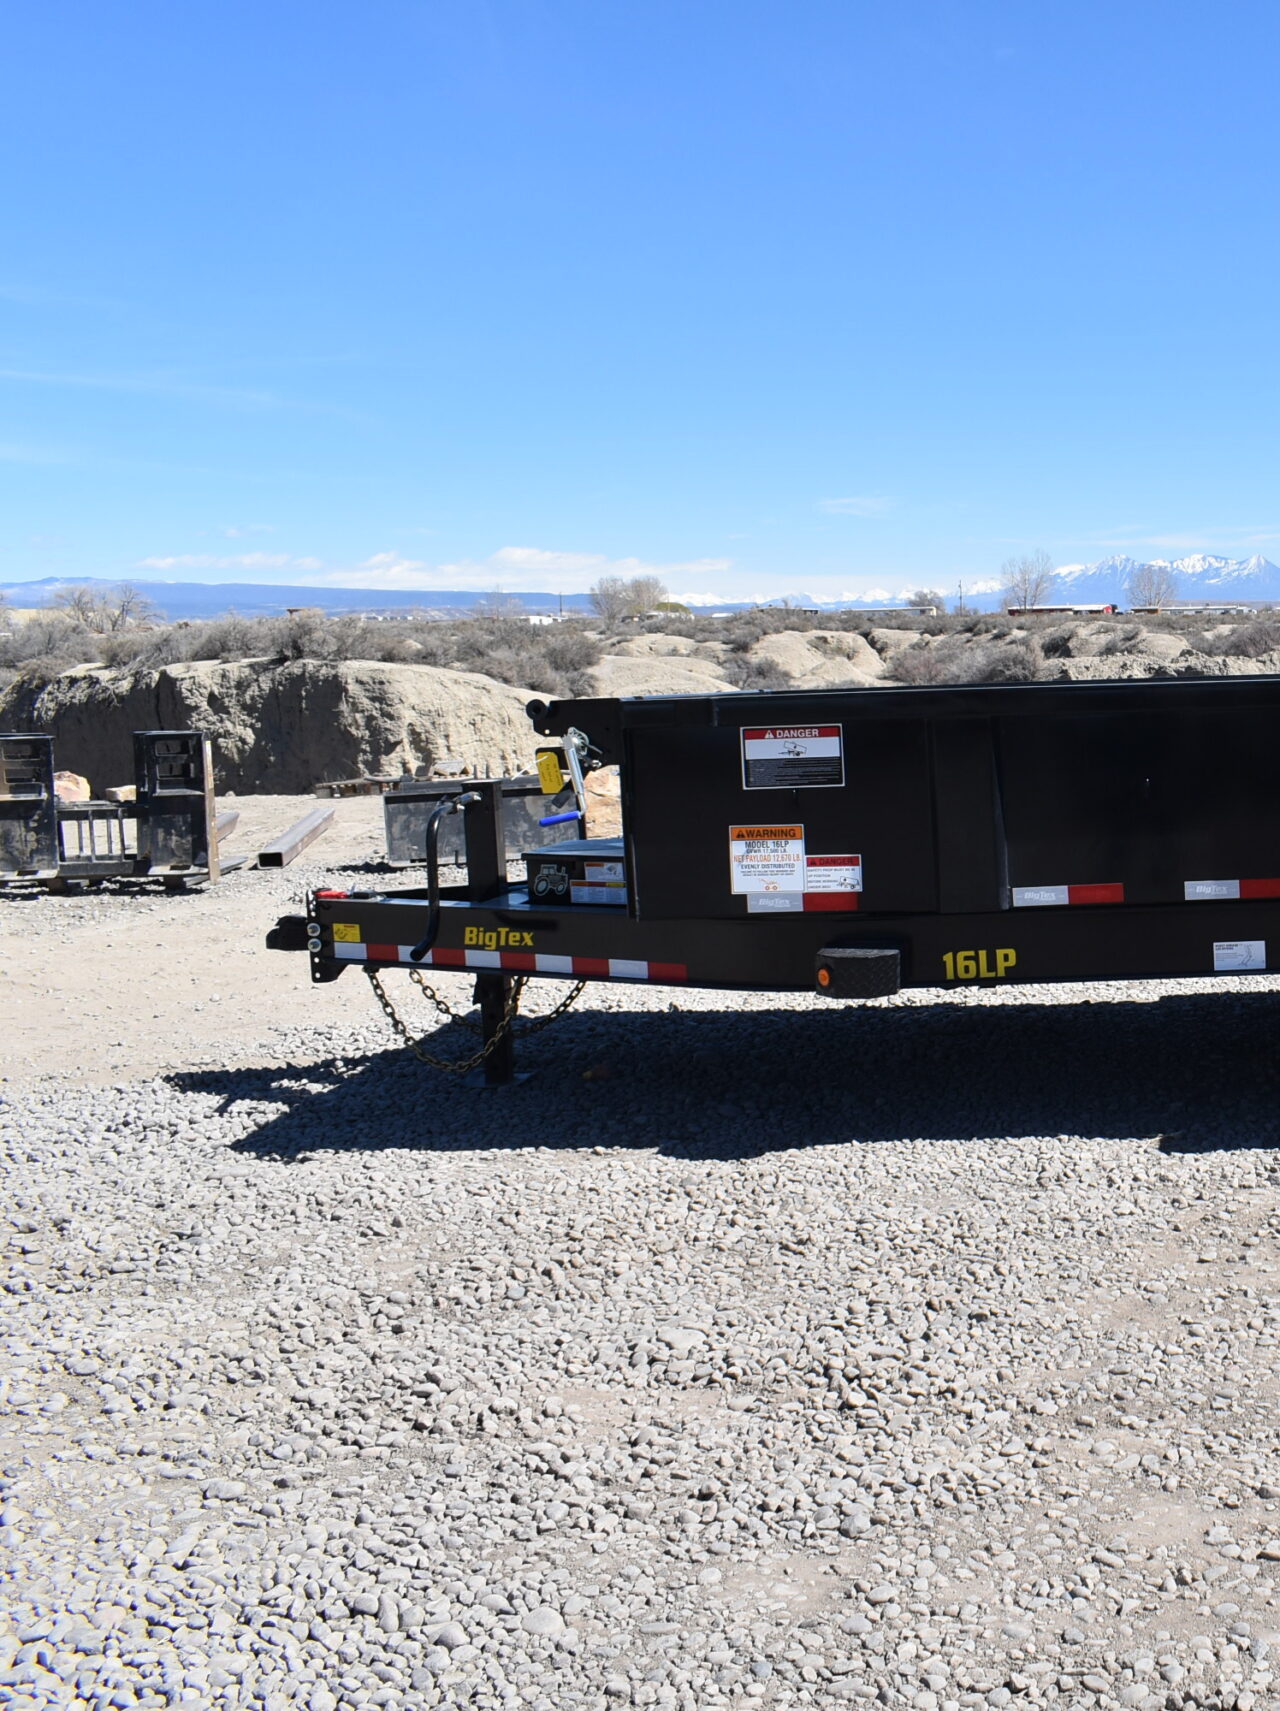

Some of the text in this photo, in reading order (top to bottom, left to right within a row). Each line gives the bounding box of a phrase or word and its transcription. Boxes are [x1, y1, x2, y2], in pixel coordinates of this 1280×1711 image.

[776, 728, 819, 738] DANGER
[745, 828, 796, 838] WARNING
[745, 840, 790, 849] MODEL 16LP
[734, 855, 745, 863] NET
[745, 854, 772, 863] PAYLOAD
[772, 854, 792, 862] 12,670
[463, 926, 534, 950] BigTex
[942, 948, 1017, 980] 16LP
